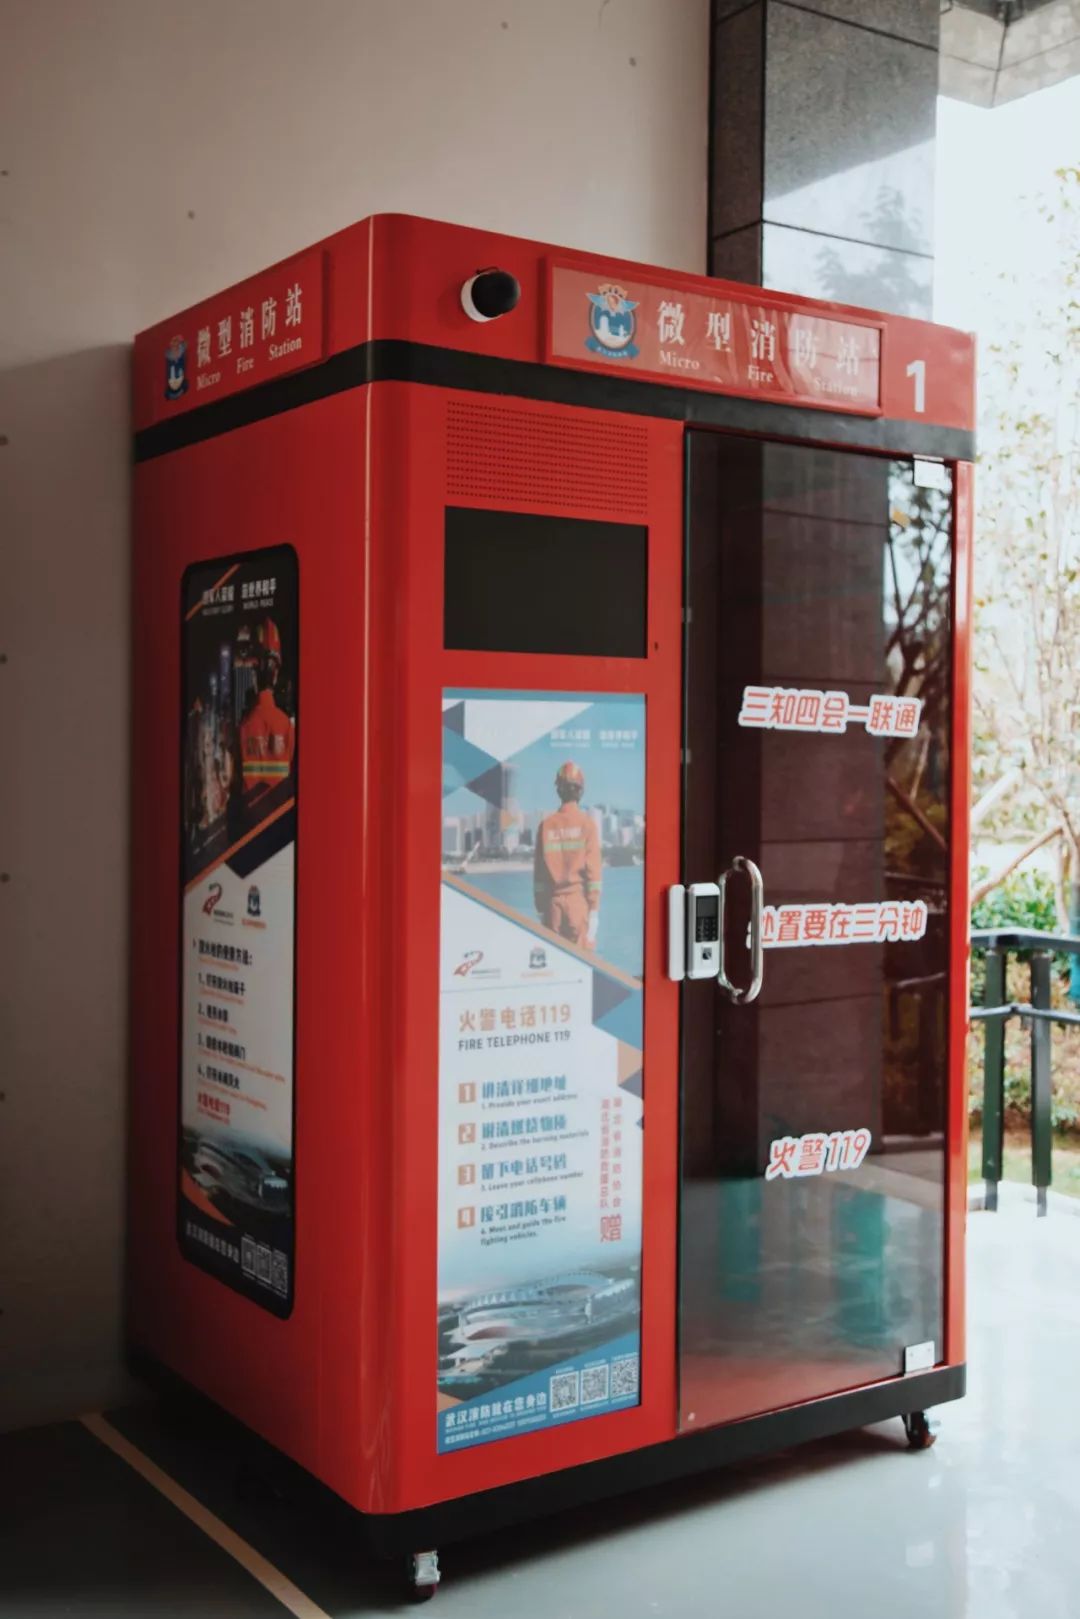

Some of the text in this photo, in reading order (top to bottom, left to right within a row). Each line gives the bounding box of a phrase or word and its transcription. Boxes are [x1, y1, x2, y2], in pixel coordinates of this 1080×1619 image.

[197, 283, 302, 369] 微型消防站
[657, 300, 859, 376] 微型消防站
[196, 337, 302, 391] Micro Fire Station
[658, 350, 859, 397] Micro Fire Station
[906, 360, 926, 413] 1
[742, 690, 918, 733] 三知四会一联通
[458, 1030, 571, 1051] FIRE TELEPHONE 119
[459, 1004, 571, 1032] 火警电话119
[768, 1133, 867, 1173] 火警119
